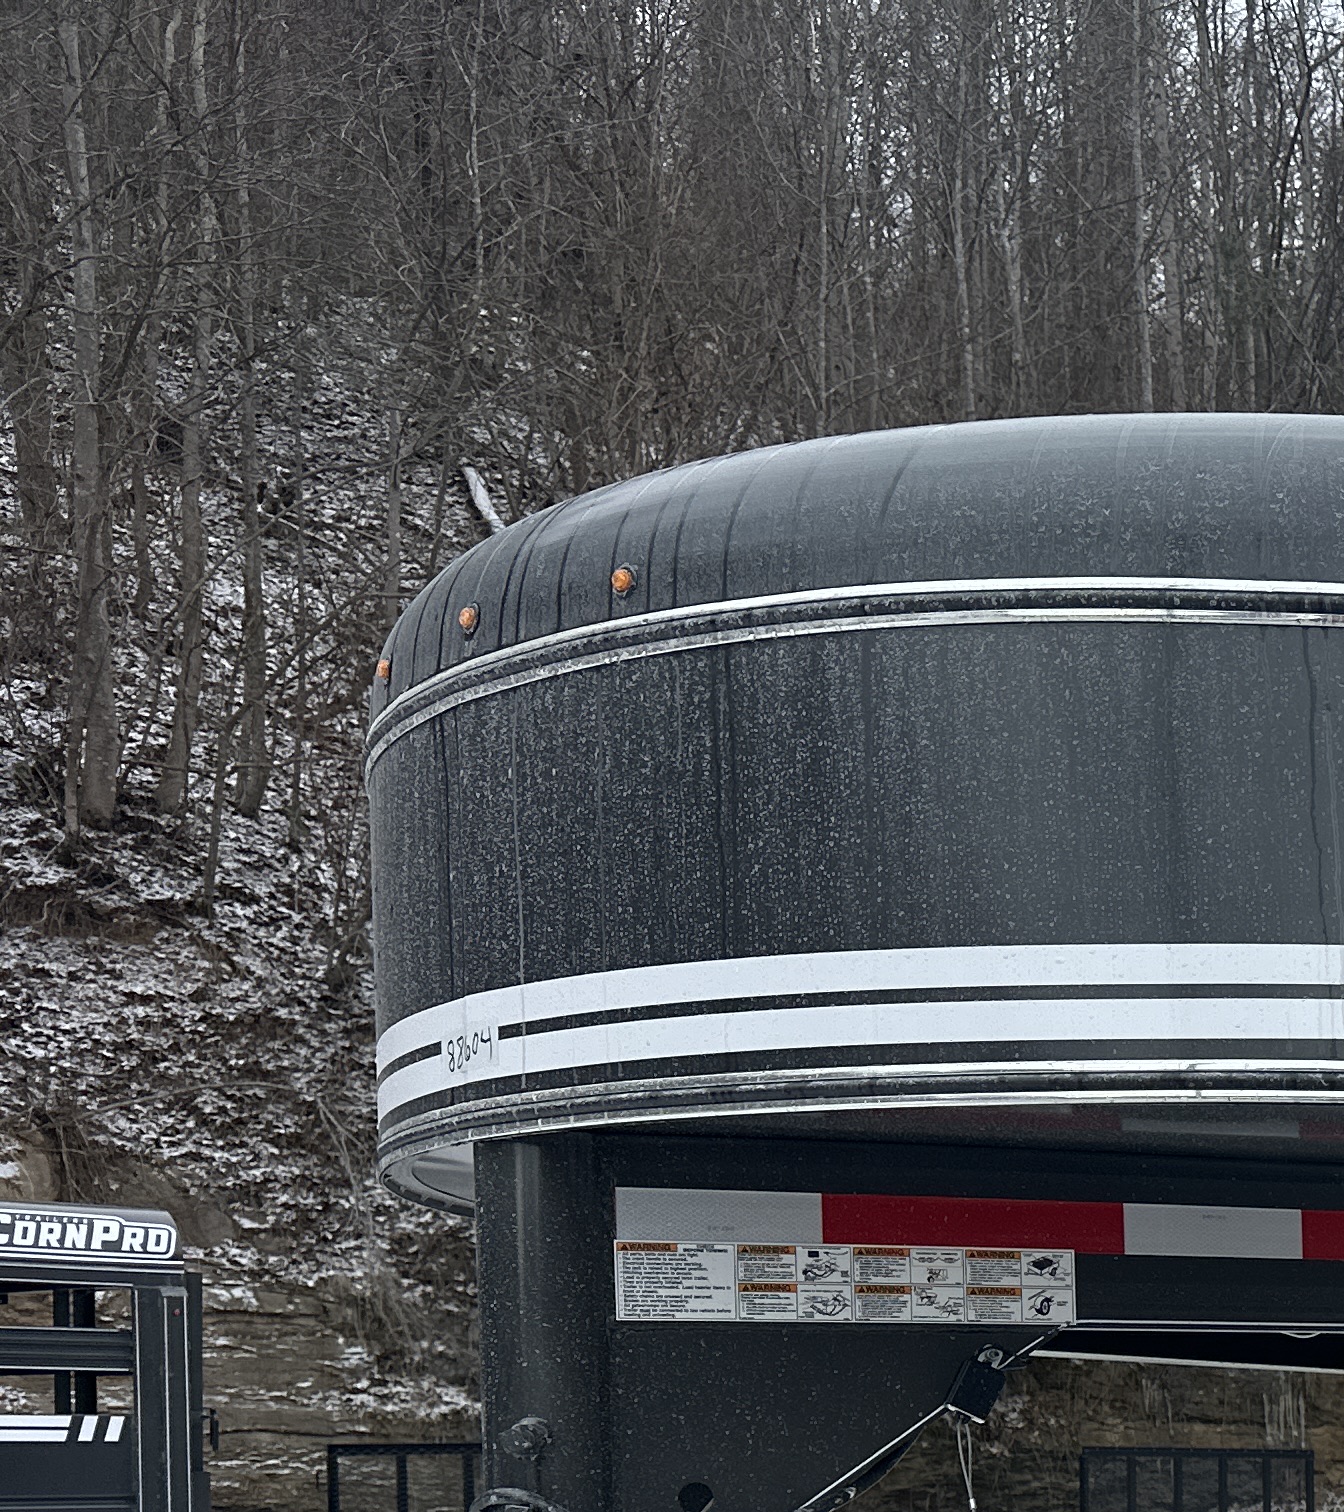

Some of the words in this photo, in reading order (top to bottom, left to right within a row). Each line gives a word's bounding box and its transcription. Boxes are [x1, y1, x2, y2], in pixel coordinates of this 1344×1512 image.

[447, 1026, 493, 1072] 88604
[628, 1242, 671, 1251] WARNING
[749, 1245, 791, 1254] WARNING
[863, 1248, 905, 1256] WARNING
[975, 1250, 1016, 1259] WARNING
[750, 1284, 792, 1293] WARNING
[864, 1286, 907, 1294] WARNING
[976, 1288, 1017, 1296] WARNING
